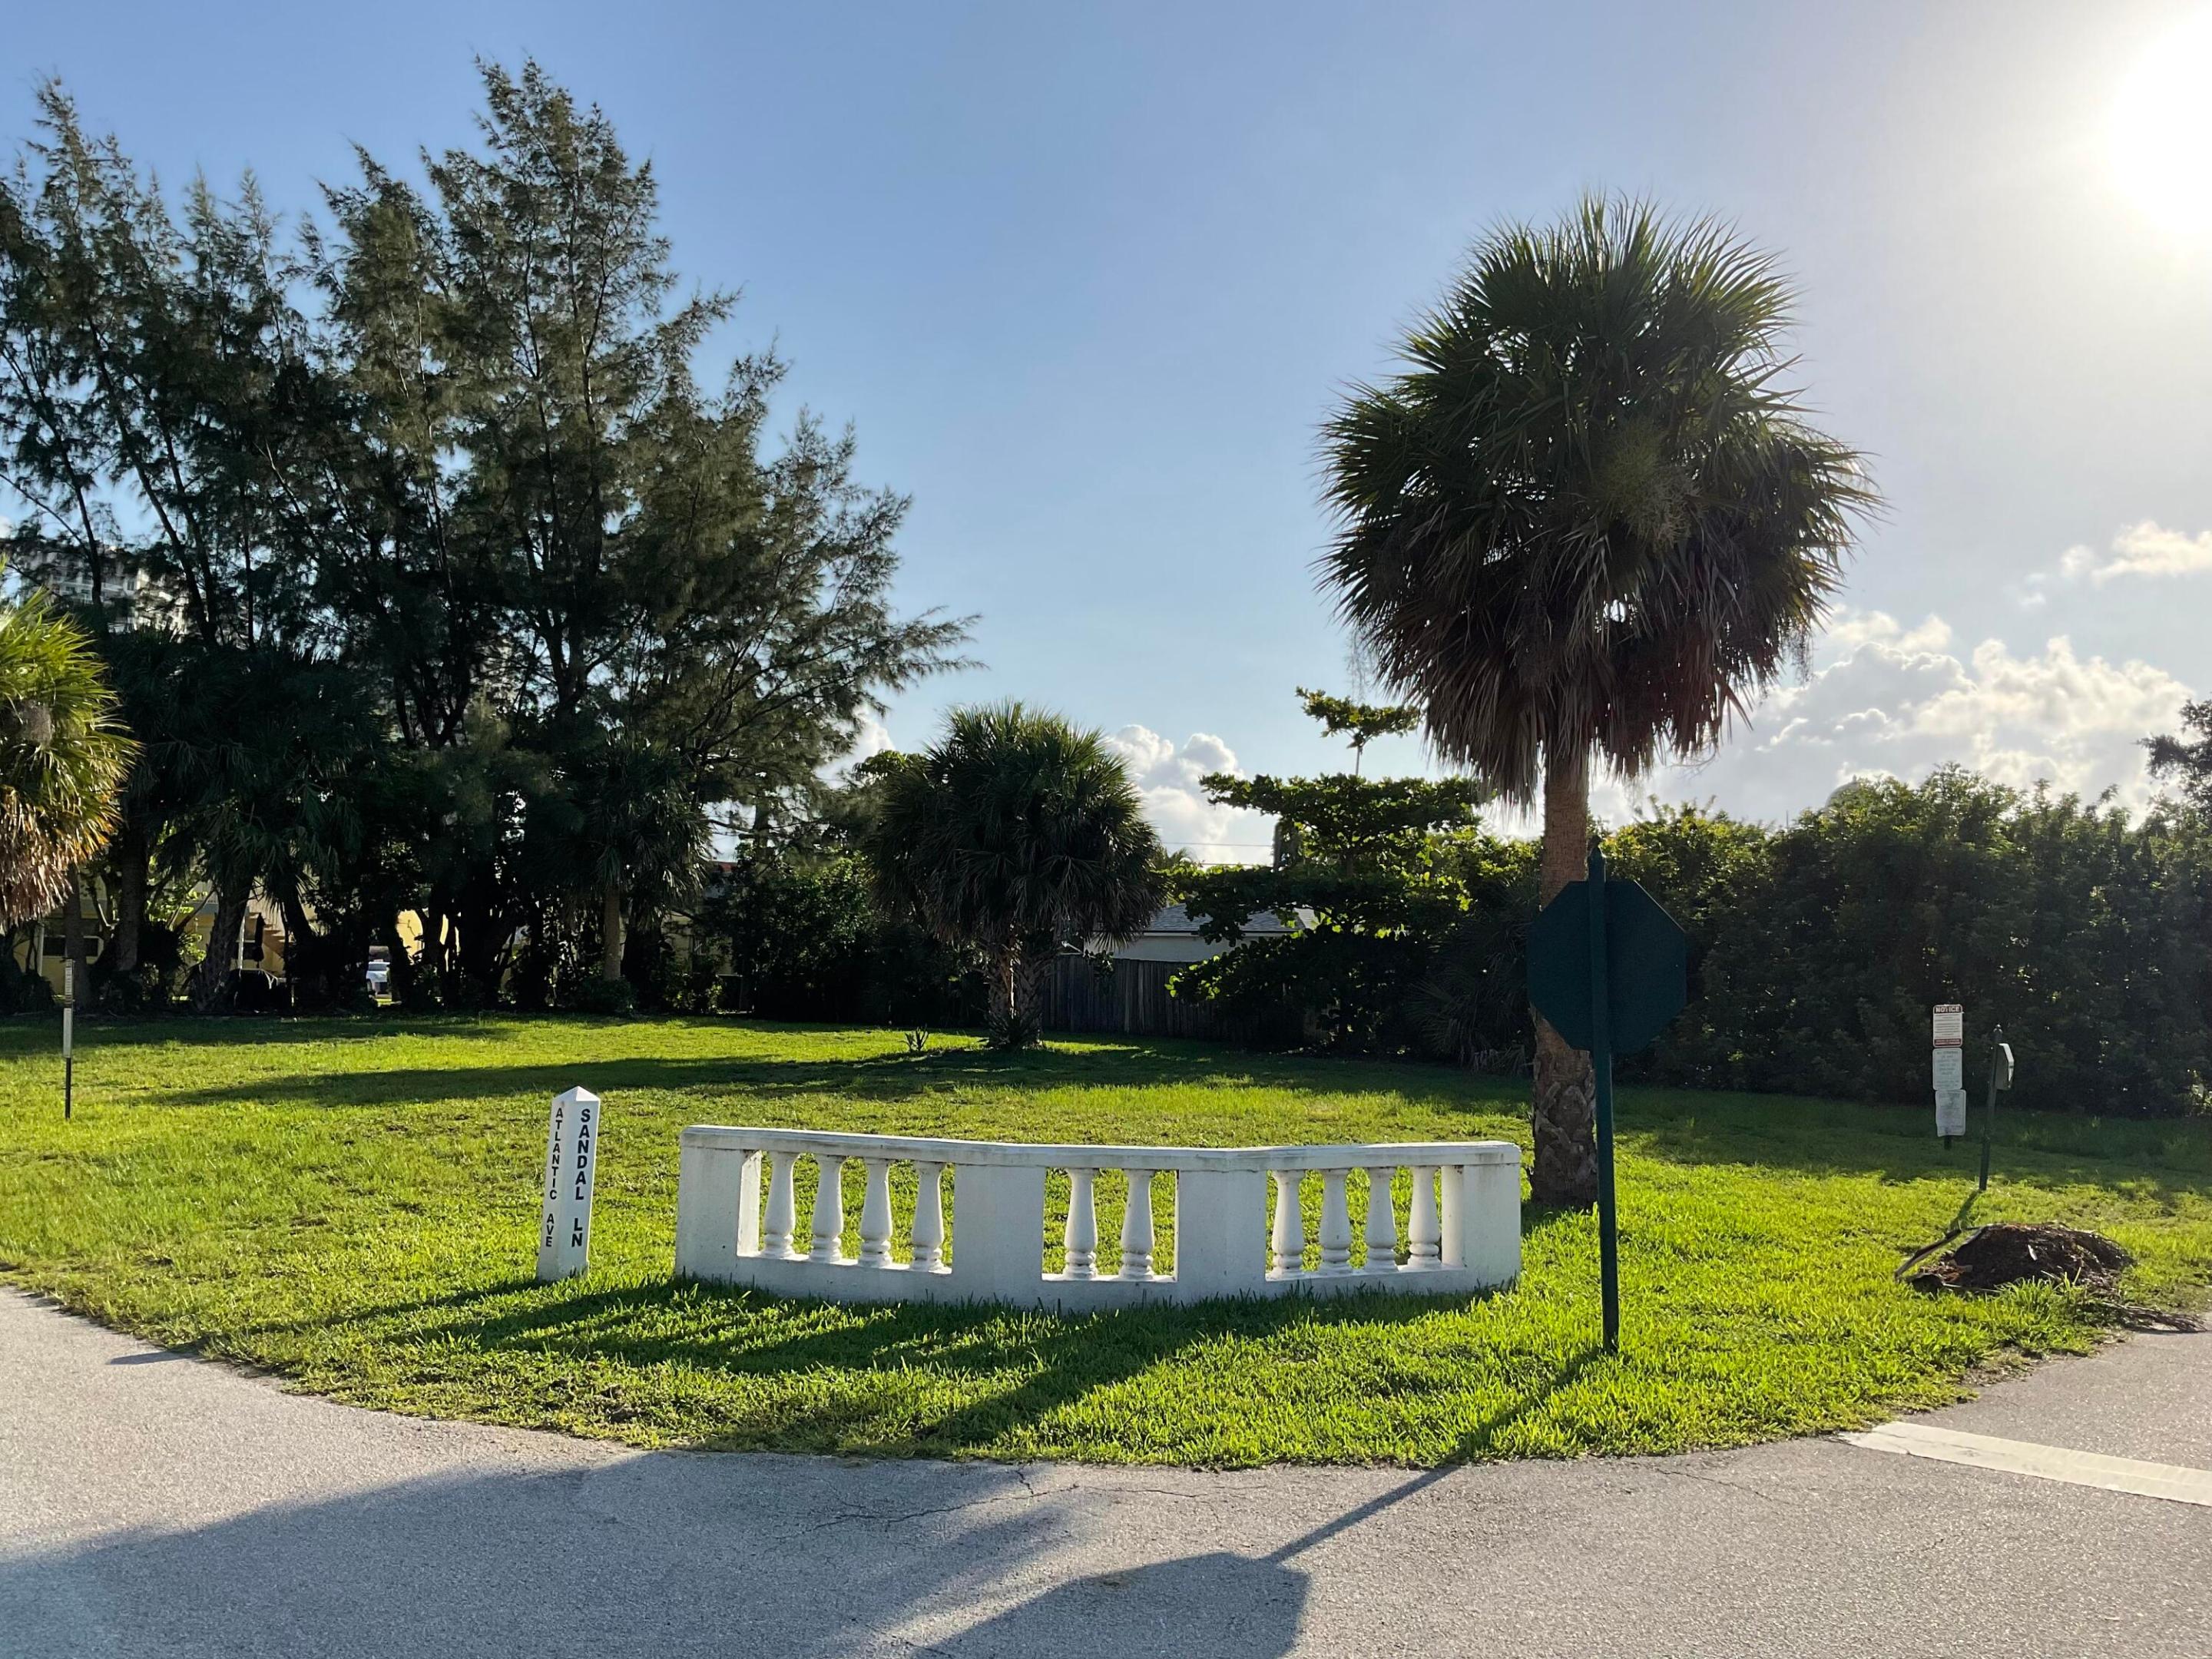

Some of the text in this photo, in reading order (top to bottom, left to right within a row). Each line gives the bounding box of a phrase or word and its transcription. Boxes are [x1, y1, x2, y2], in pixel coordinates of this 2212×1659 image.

[545, 1107, 564, 1247] ATLANTIC AVE
[571, 1108, 591, 1248] SANDAL LN
